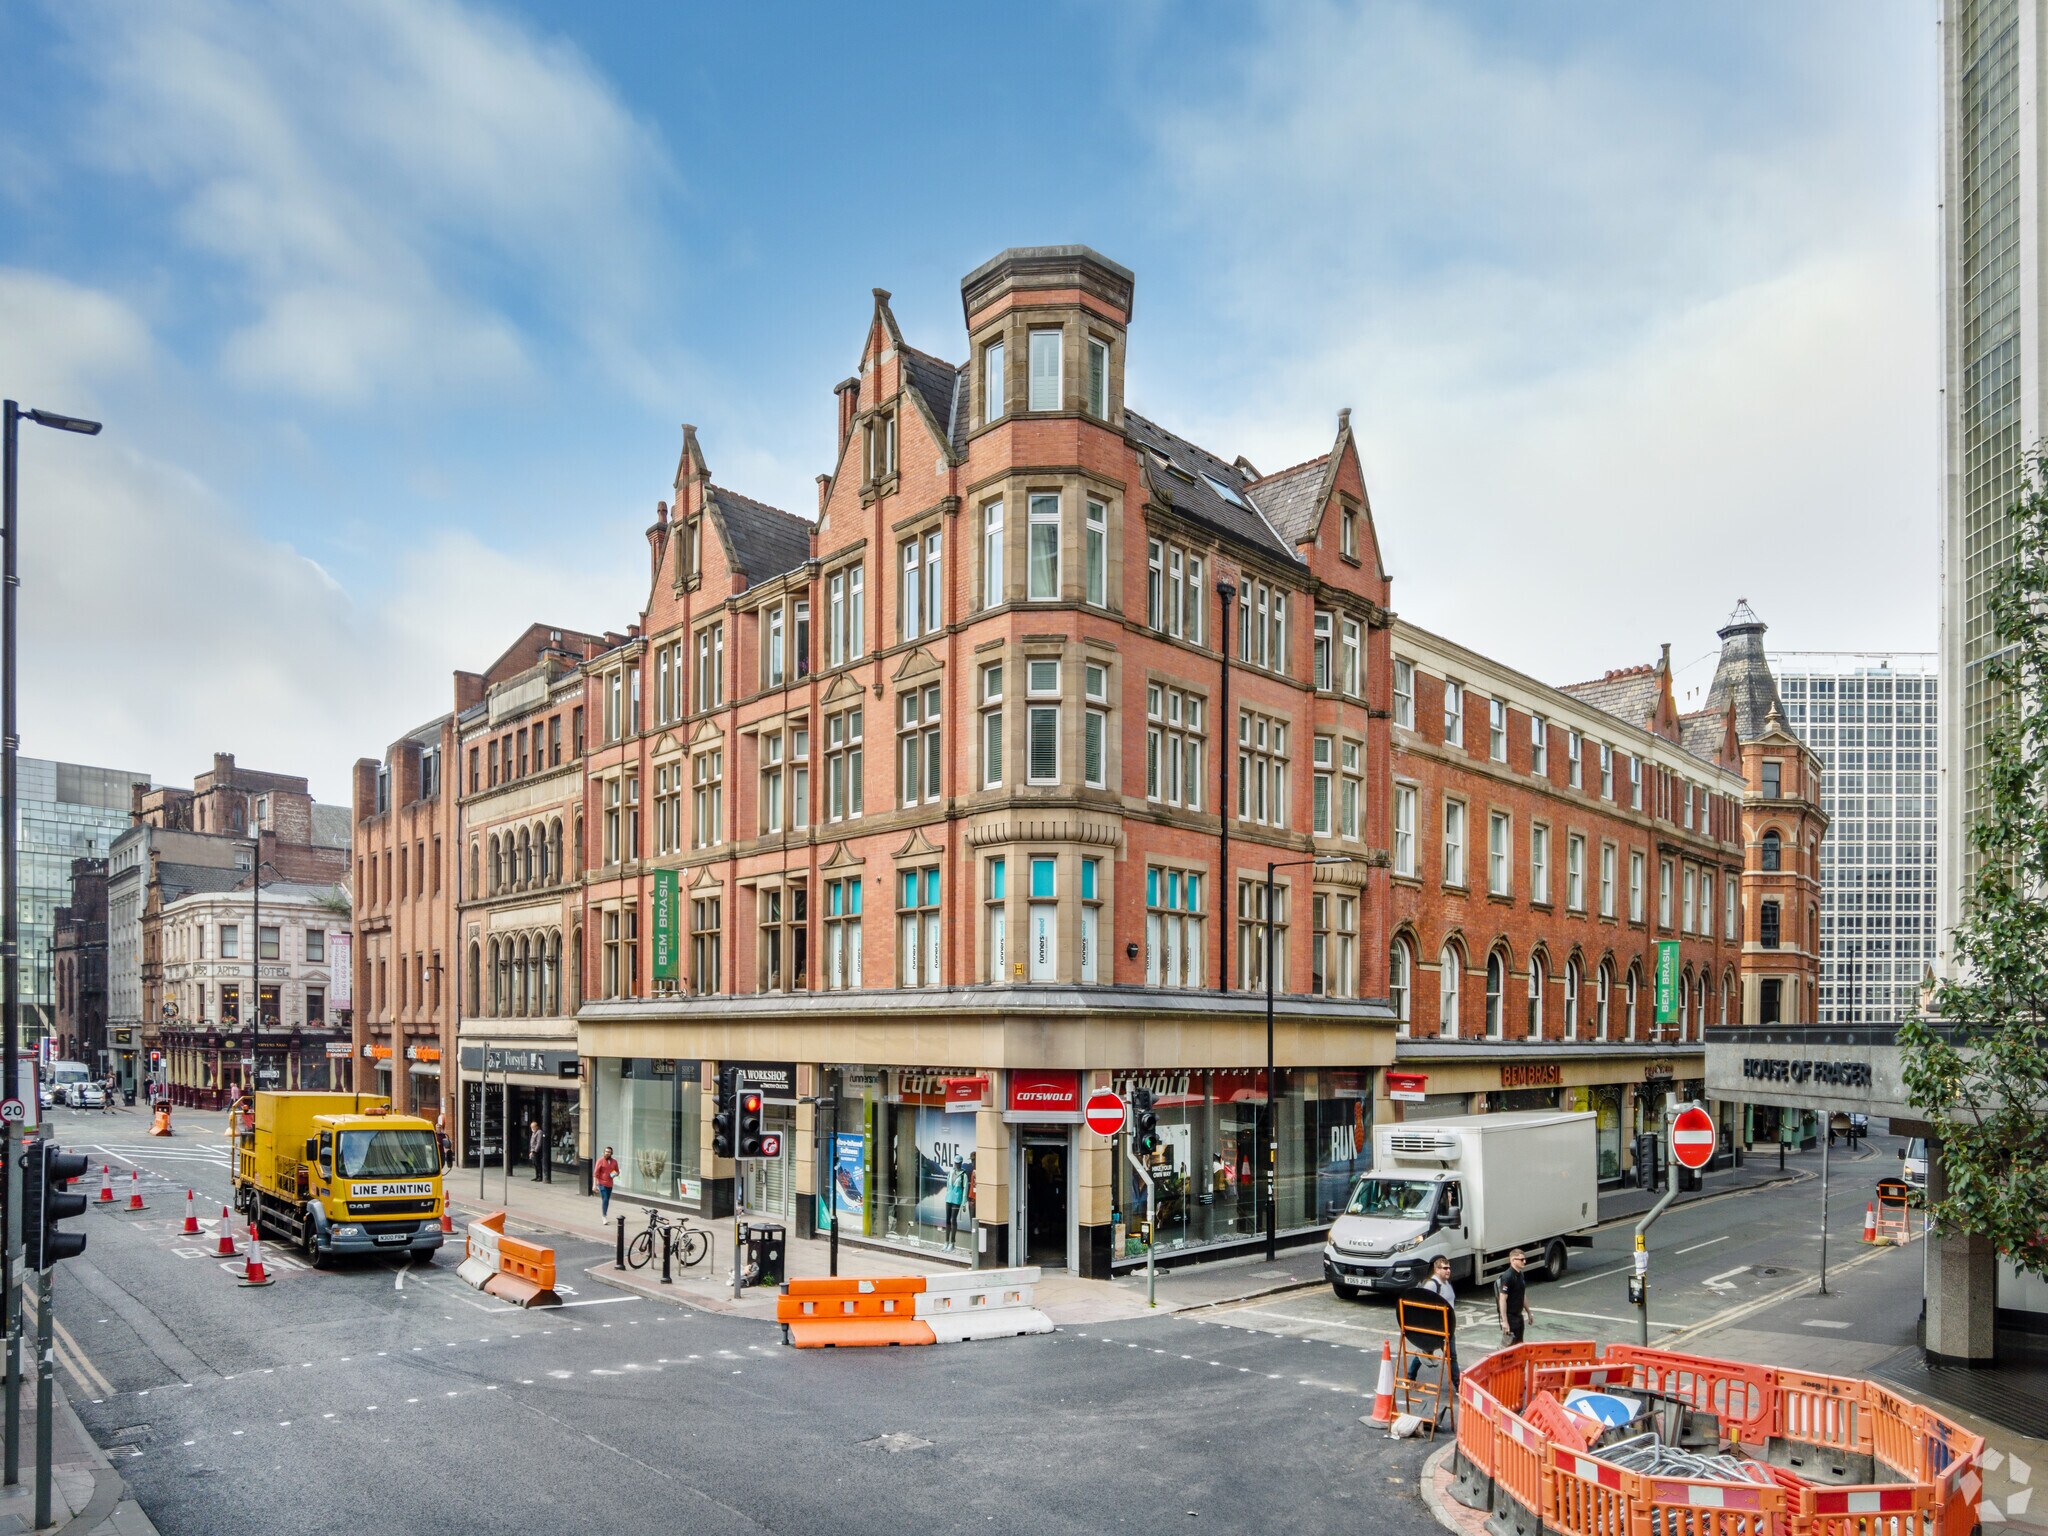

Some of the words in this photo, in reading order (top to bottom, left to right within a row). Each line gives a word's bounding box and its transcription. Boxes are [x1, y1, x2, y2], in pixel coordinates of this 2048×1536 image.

[659, 875, 668, 928] BRASIL
[658, 934, 667, 965] BEM
[217, 966, 240, 976] ARMS
[258, 966, 289, 977] HOTEL
[1662, 945, 1671, 985] BRASIL
[1661, 989, 1670, 1013] BEM
[505, 1051, 527, 1067] Forsyth
[747, 1070, 787, 1081] WORKSHOP
[1502, 1066, 1527, 1086] BEM
[1528, 1065, 1563, 1084] BRASIL
[1743, 1059, 1789, 1081] HOUSE
[1790, 1060, 1812, 1082] OF
[1813, 1061, 1872, 1086] FRASER
[1016, 1092, 1073, 1101] COTSWOLD
[3, 1106, 22, 1116] 20
[1331, 1124, 1358, 1162] RUN
[934, 1142, 959, 1167] SALE
[353, 1185, 377, 1195] LINE
[382, 1184, 431, 1194] PAINTING
